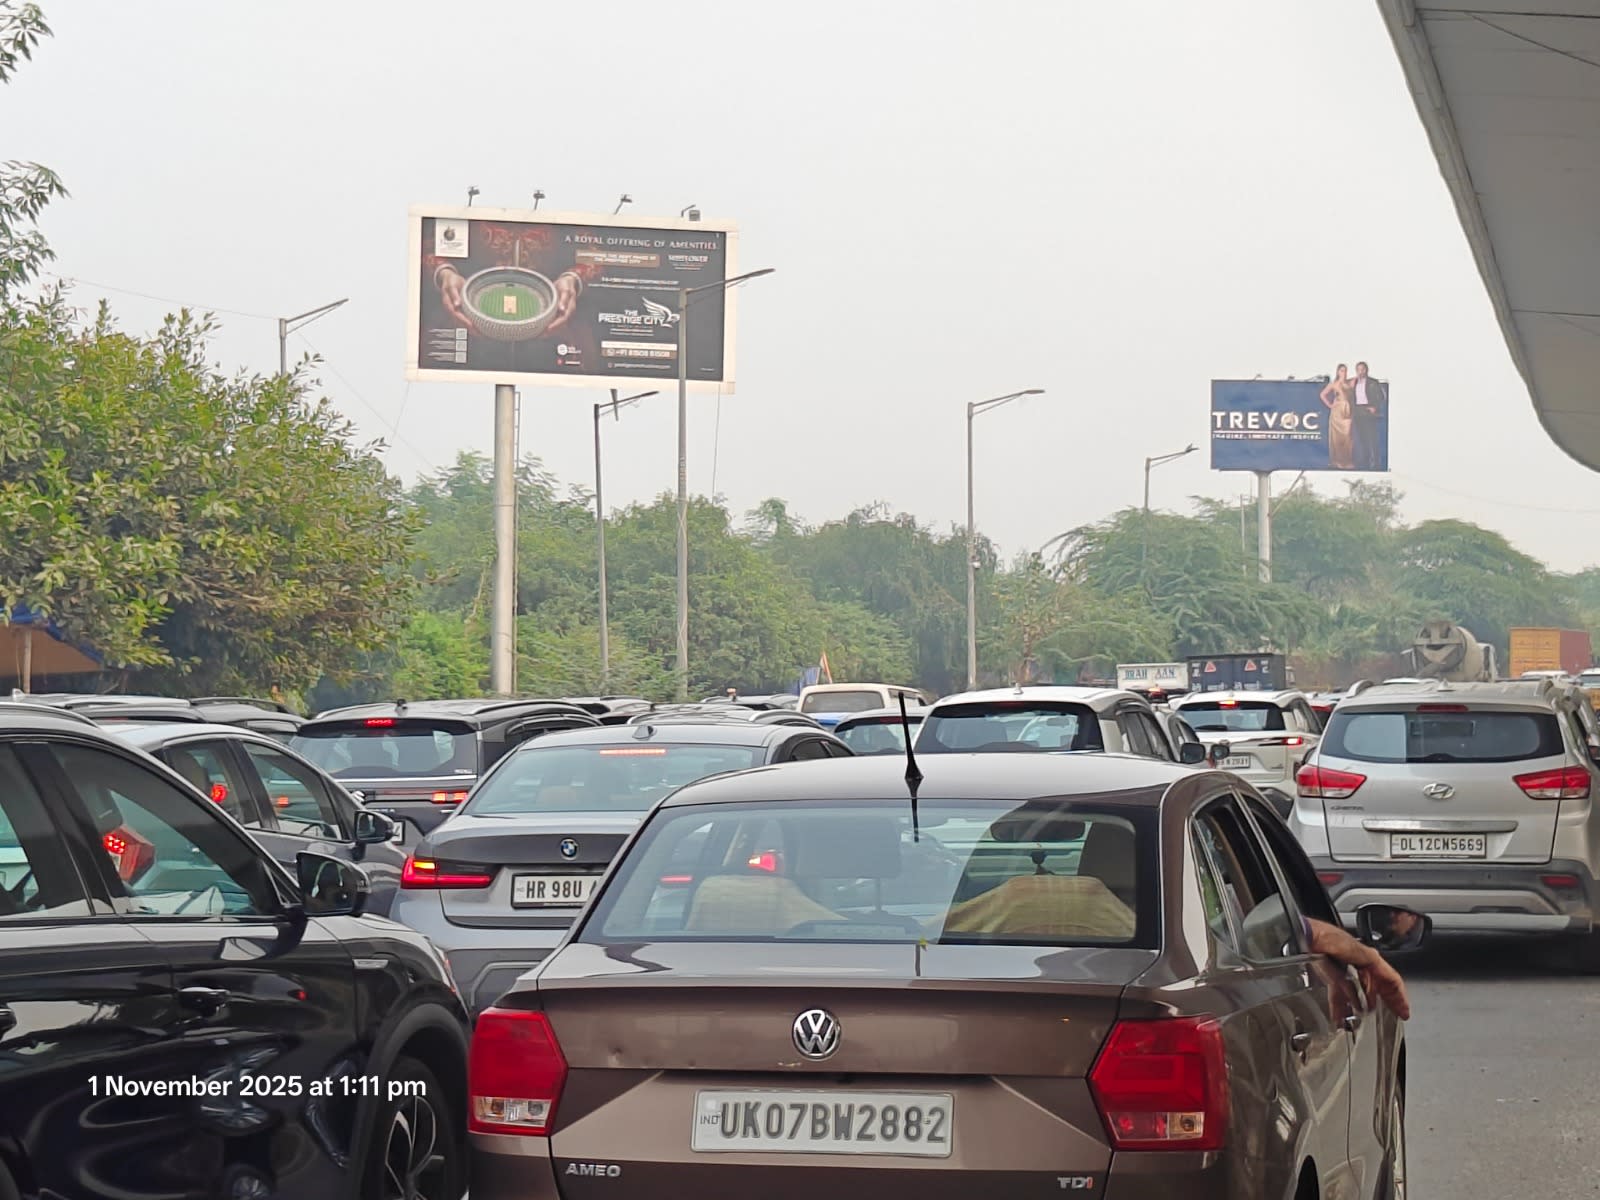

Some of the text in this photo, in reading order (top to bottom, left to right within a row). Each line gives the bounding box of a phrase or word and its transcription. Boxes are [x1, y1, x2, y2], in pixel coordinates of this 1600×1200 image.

[574, 235, 603, 244] ROYAL
[607, 237, 651, 247] OFFERING
[654, 240, 666, 248] OF
[669, 241, 717, 250] AMENITIES
[598, 312, 665, 327] PRESTIGE CITY
[1212, 411, 1319, 430] TREVOC
[1400, 838, 1483, 851] DL12CN5669
[526, 880, 546, 898] HR
[552, 880, 582, 898] 98U
[719, 1101, 947, 1143] UK07BW2882
[565, 1162, 621, 1177] AMEO
[1057, 1177, 1093, 1189] TDI
